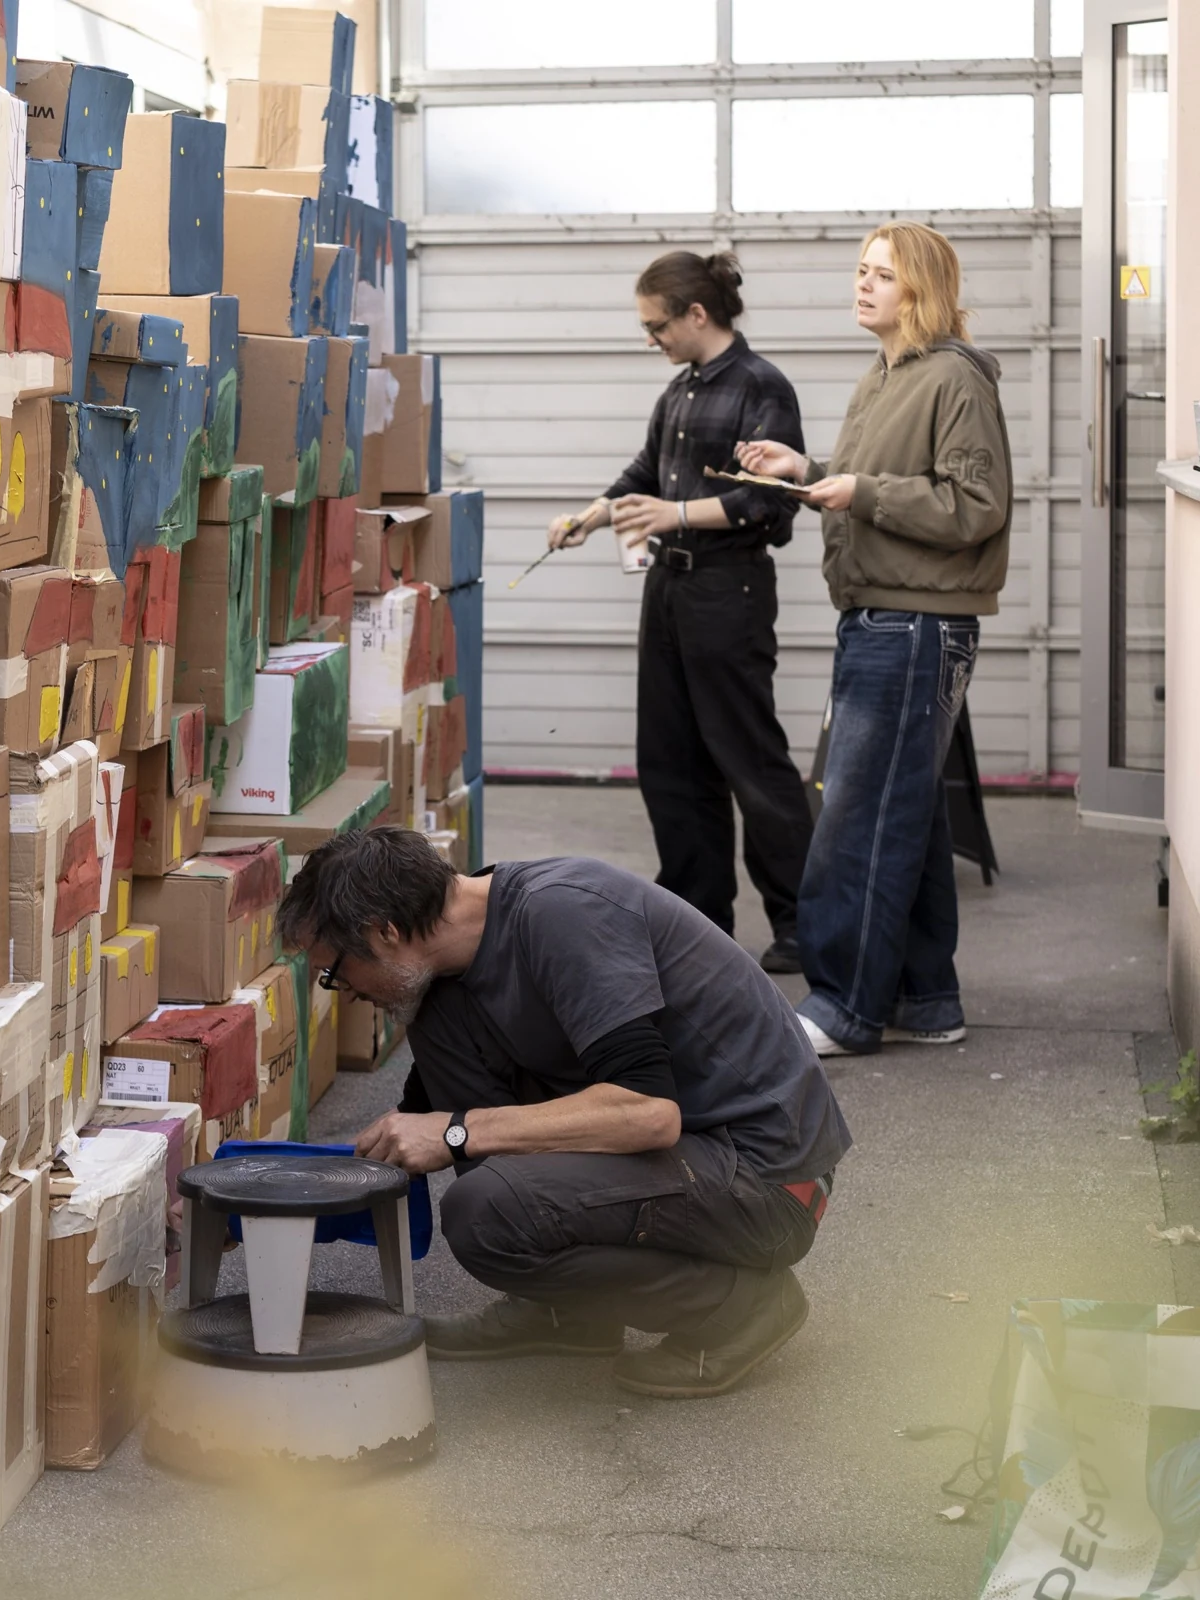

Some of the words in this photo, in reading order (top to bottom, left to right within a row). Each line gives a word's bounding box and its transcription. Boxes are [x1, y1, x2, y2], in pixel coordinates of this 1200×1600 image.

[945, 447, 993, 489] 92
[241, 788, 275, 802] Viking
[107, 1061, 126, 1071] QD23
[137, 1065, 145, 1073] 60
